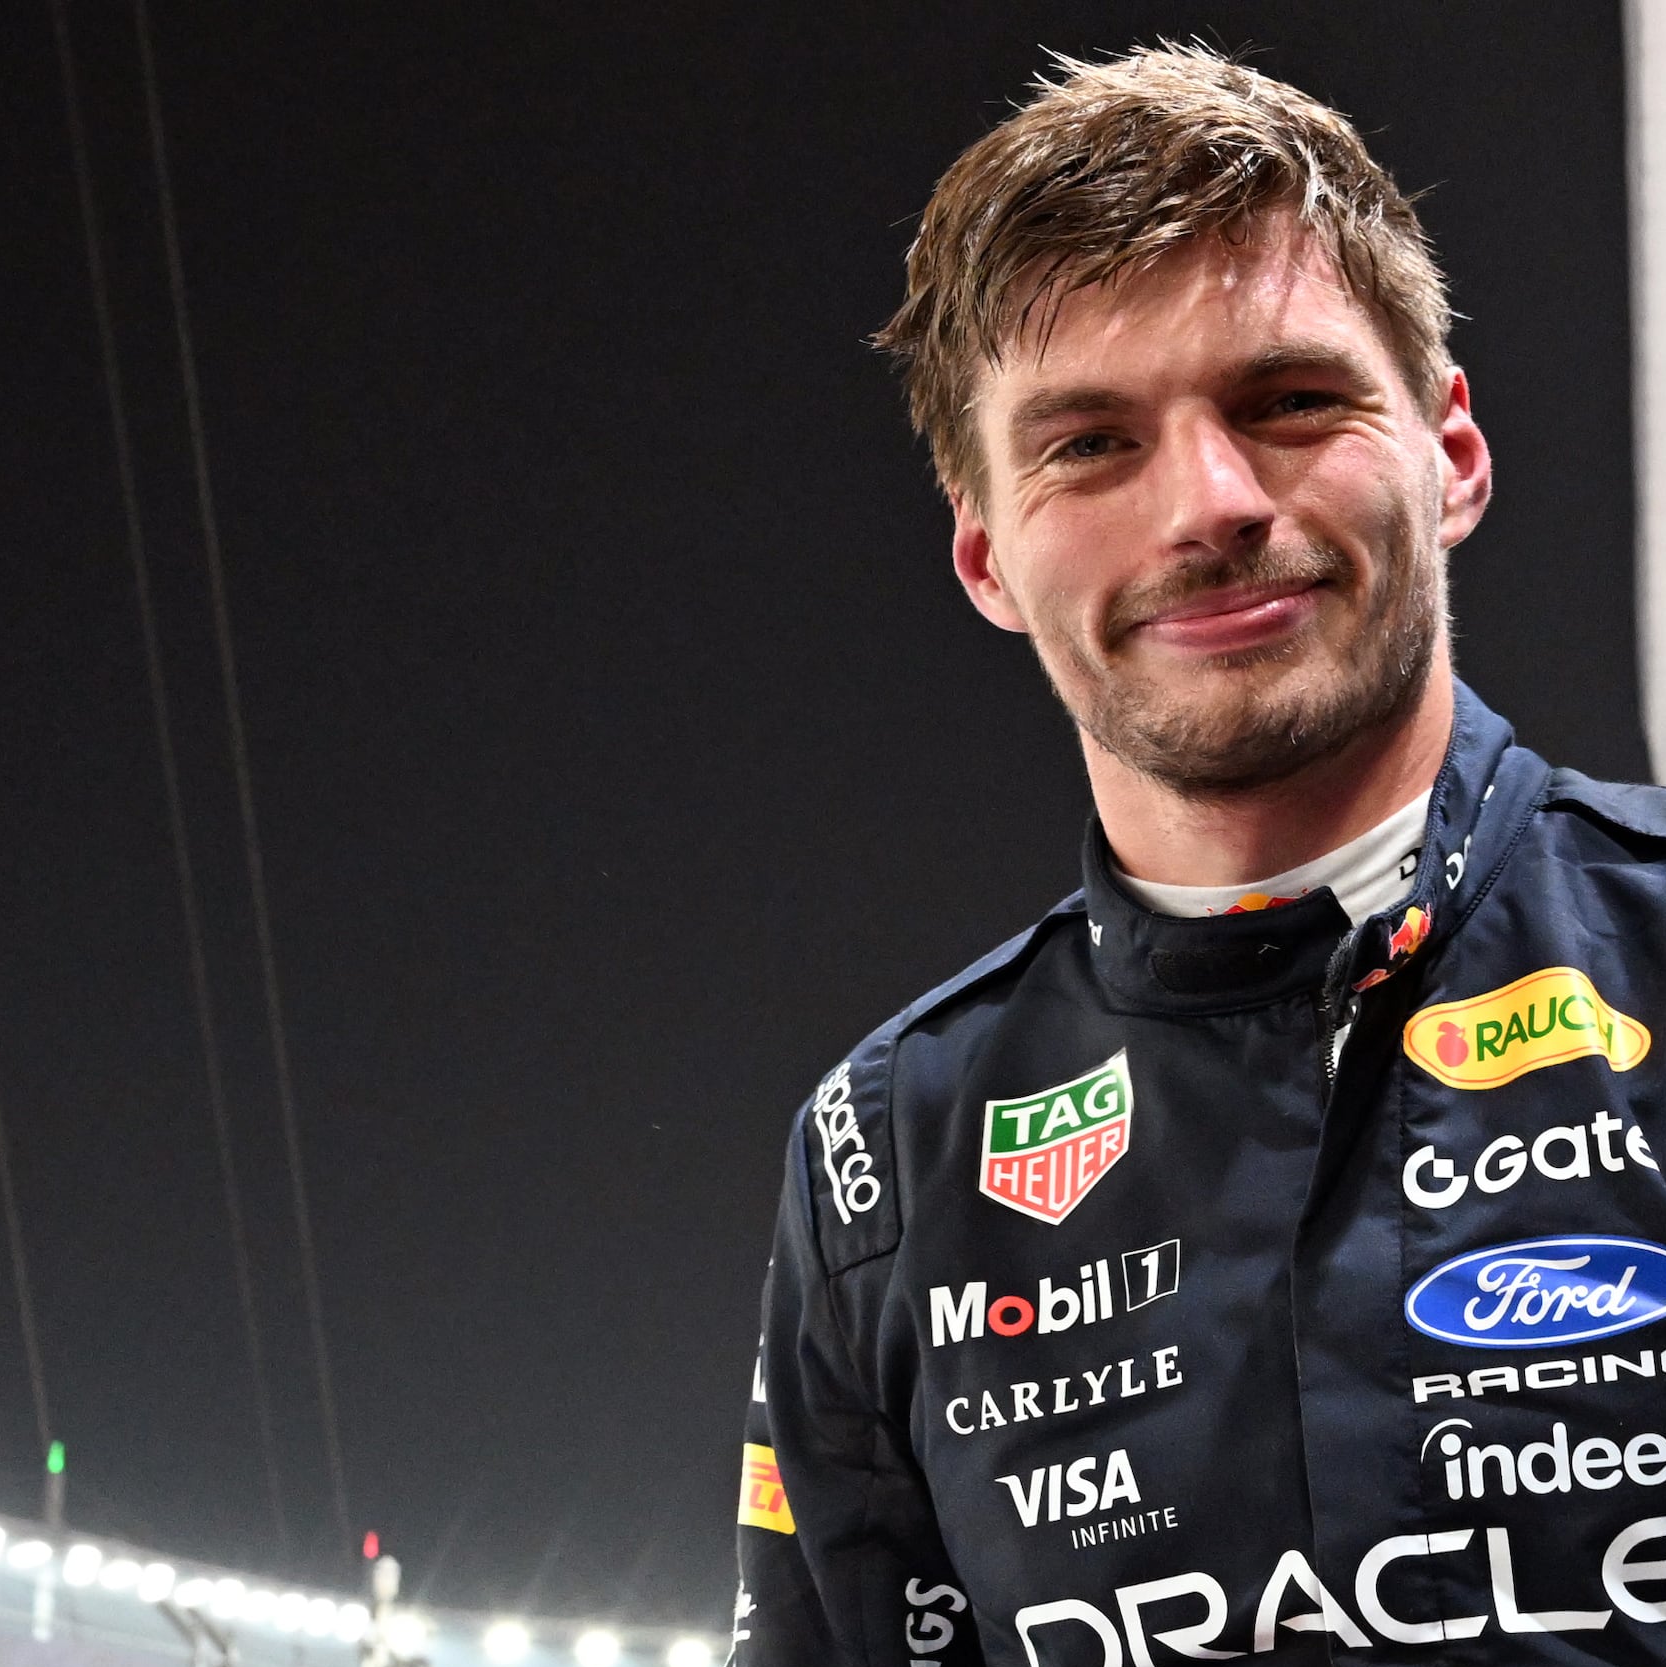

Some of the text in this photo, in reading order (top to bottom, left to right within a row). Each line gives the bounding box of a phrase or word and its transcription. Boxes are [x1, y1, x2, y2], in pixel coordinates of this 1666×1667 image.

[1001, 1074, 1120, 1145] TAG
[993, 1126, 1121, 1212] HEUER
[930, 1258, 1113, 1347] Mobil
[1464, 1255, 1637, 1331] Ford
[945, 1345, 1183, 1435] CARLYLE
[994, 1449, 1141, 1528] VISA
[1070, 1506, 1179, 1550] INFINITE
